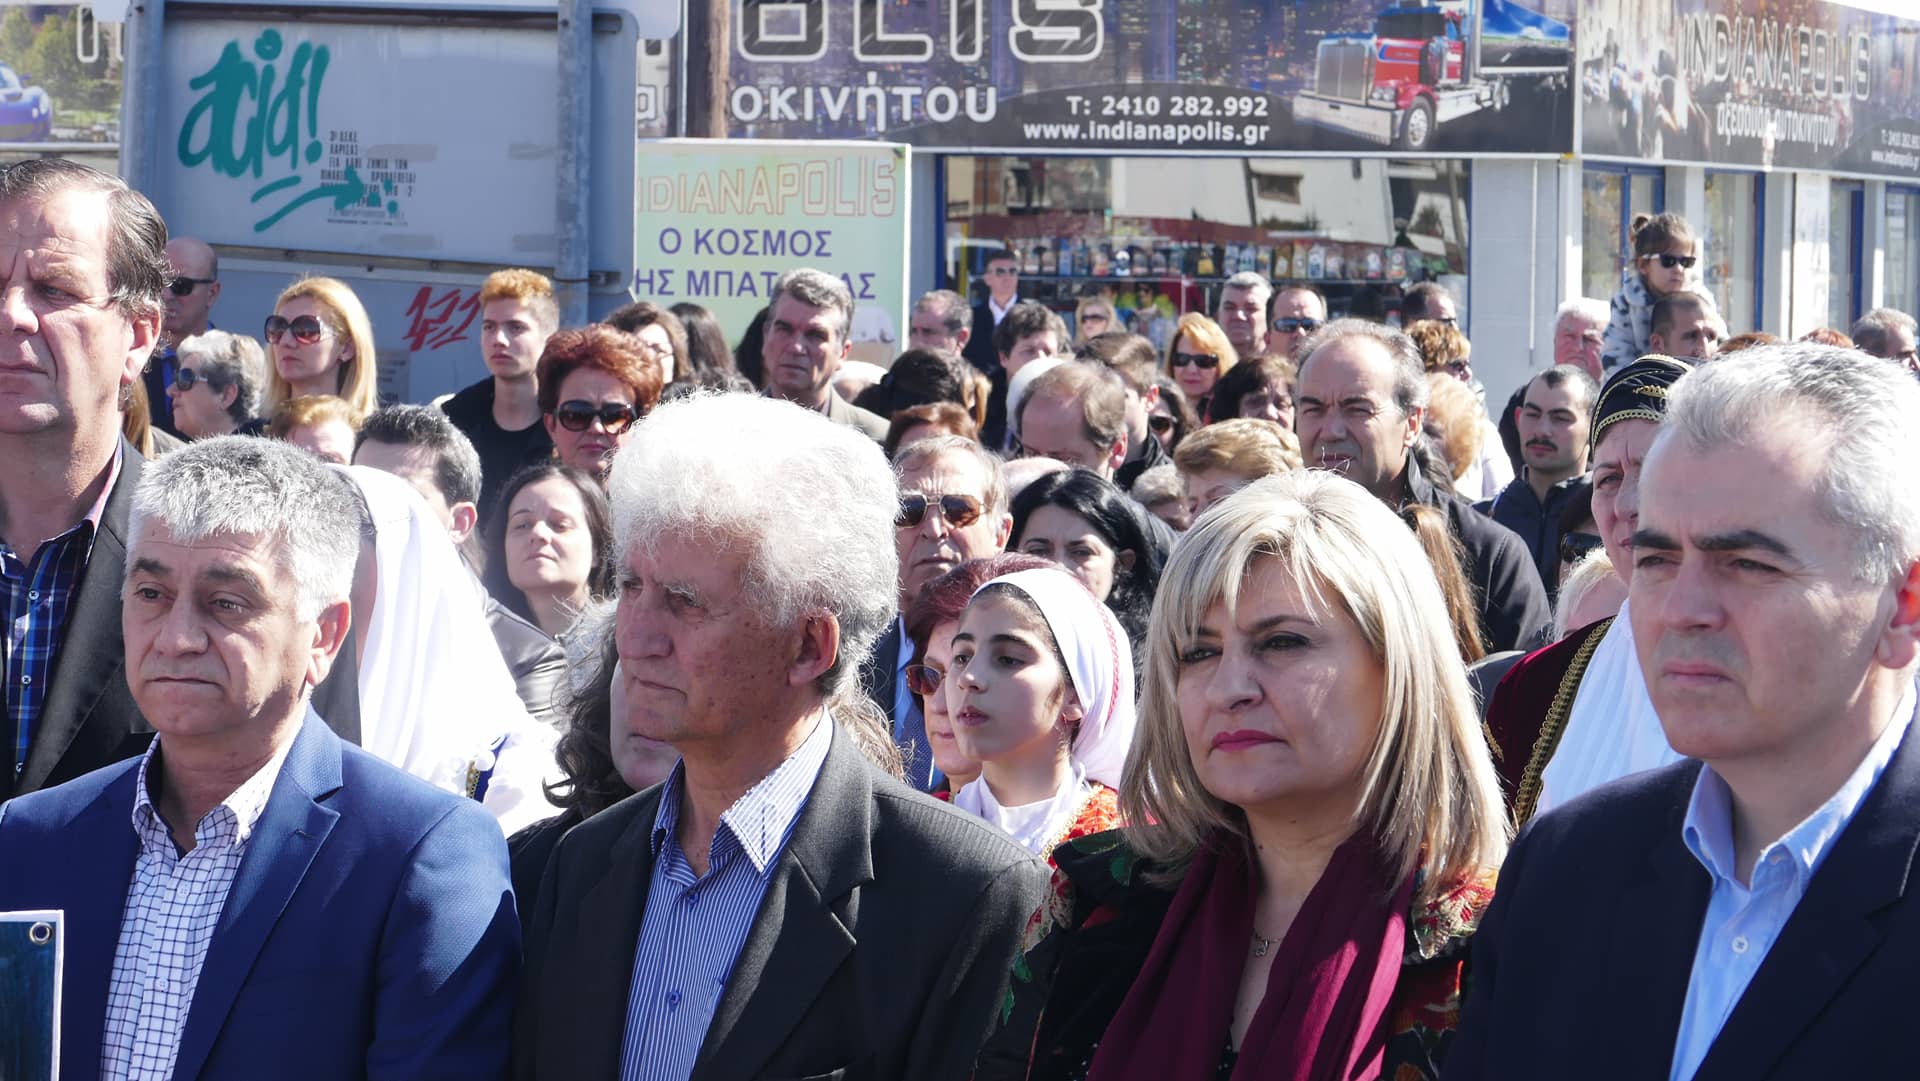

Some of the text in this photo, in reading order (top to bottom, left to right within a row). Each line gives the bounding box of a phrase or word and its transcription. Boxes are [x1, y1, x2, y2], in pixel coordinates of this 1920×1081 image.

[1679, 12, 1871, 101] INDIANAPOLIS
[1066, 96, 1269, 117] T: 2410 282.992
[1024, 121, 1270, 145] www.indianapolis.gr
[637, 157, 898, 217] DIANAPOLIS
[659, 228, 832, 257] Ο ΚΟΣΜΟΣ
[635, 269, 675, 296] ΗΣ
